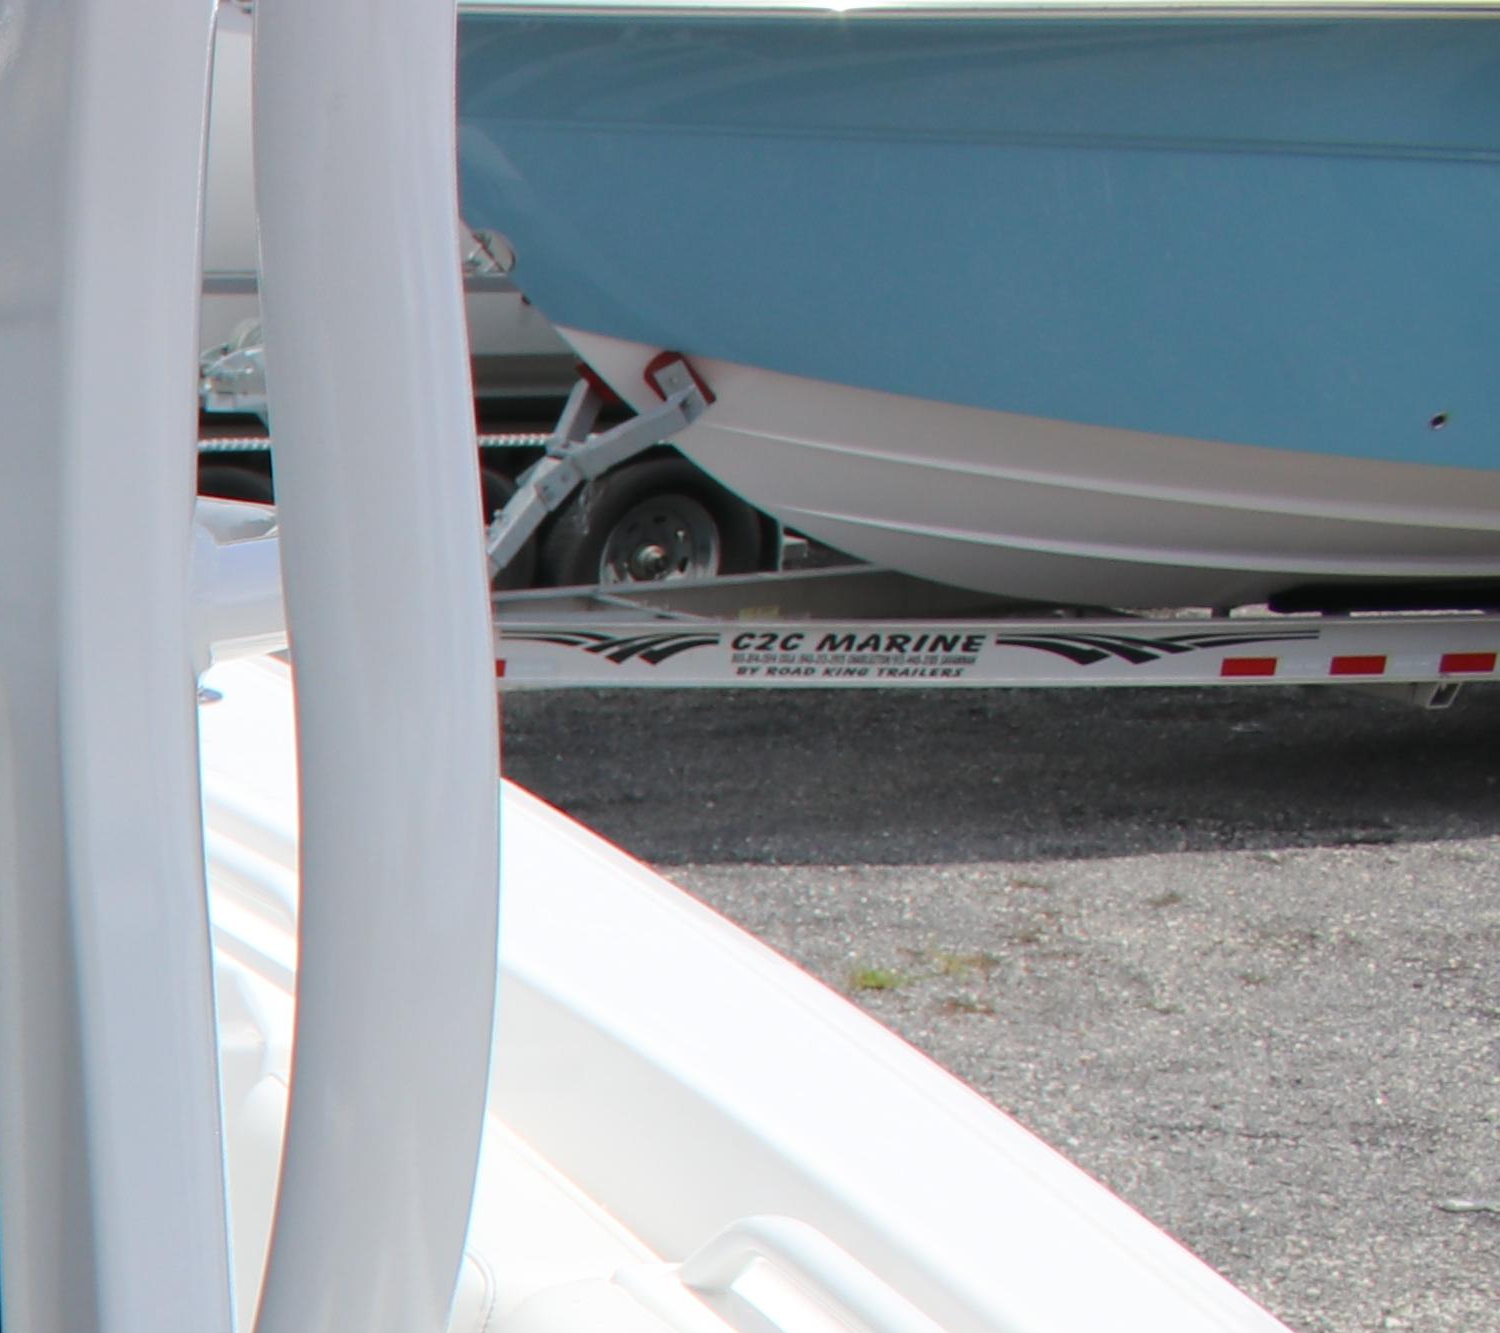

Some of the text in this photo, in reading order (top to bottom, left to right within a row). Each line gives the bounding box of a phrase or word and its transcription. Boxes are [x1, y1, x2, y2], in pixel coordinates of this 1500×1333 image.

[731, 632, 986, 653] C2C MARINE
[736, 666, 964, 678] BY ROAD KING TRAILERS
